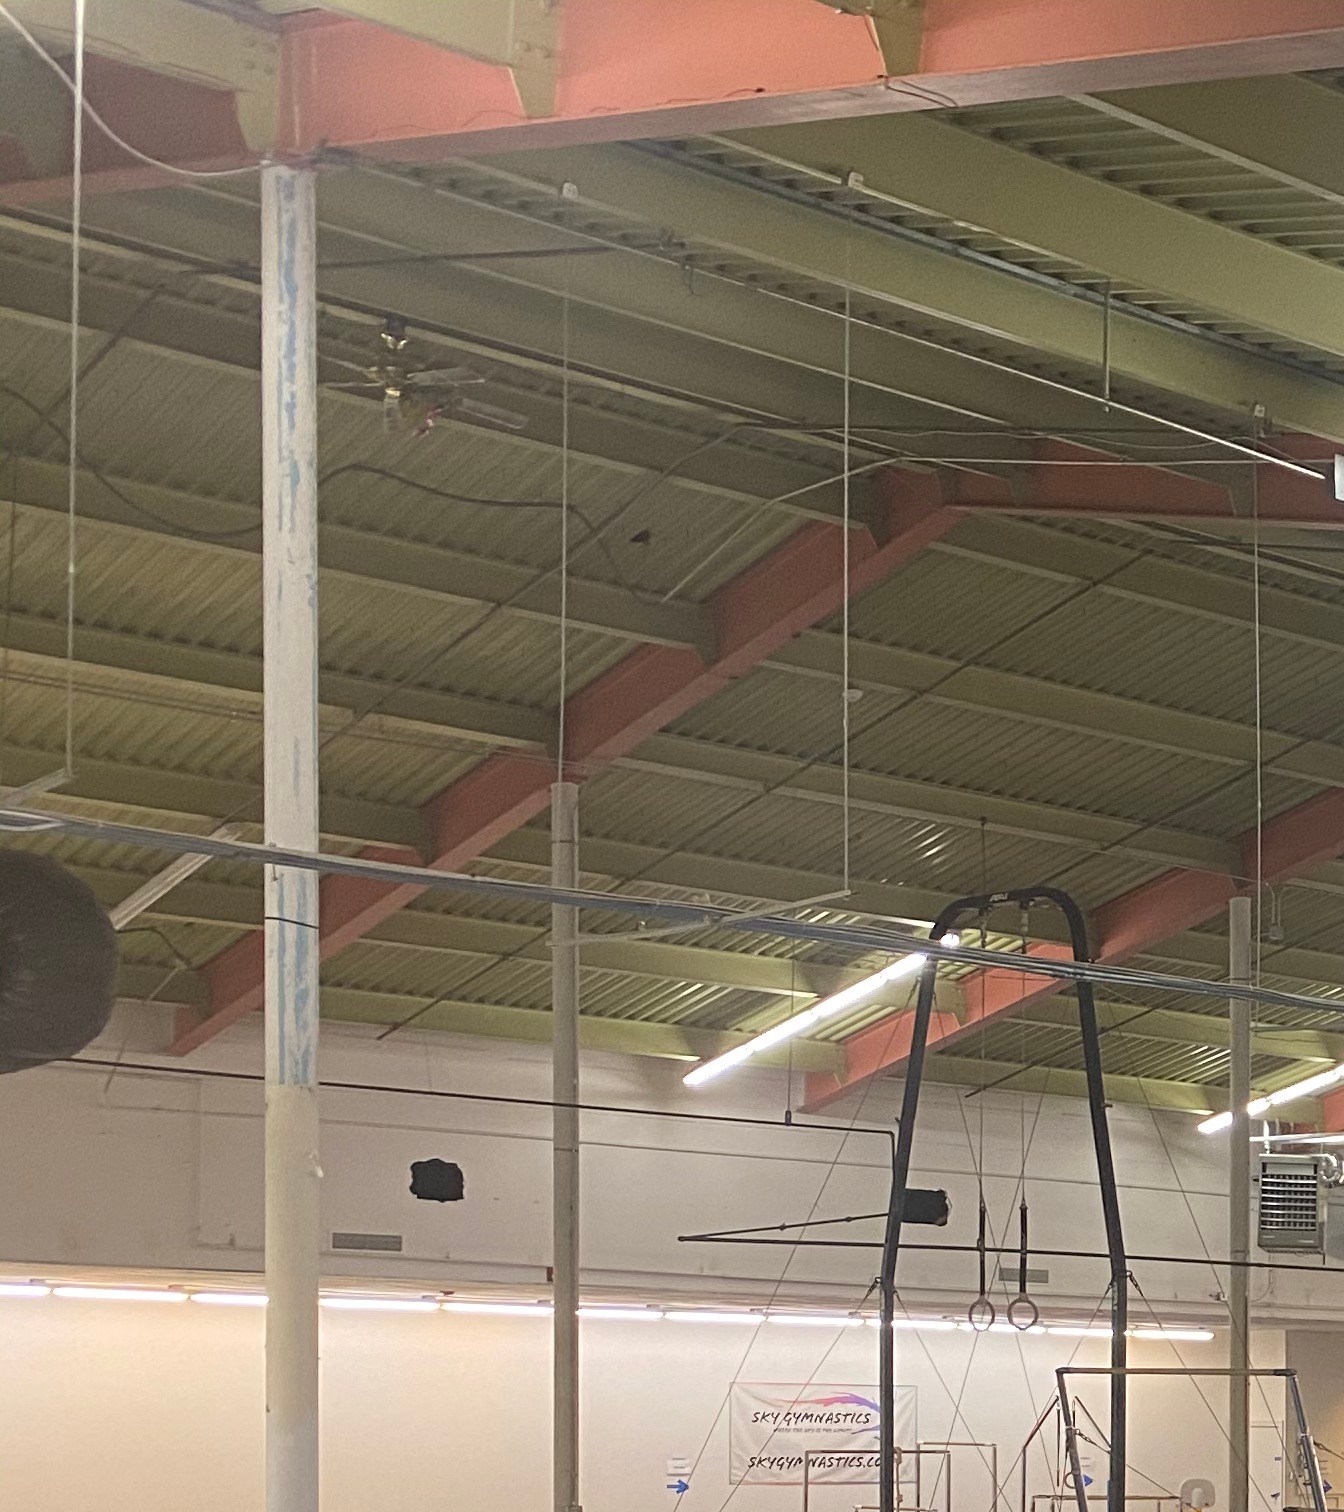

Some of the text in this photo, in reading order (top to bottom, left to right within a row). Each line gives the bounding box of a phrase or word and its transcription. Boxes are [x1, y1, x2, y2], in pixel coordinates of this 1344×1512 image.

[752, 1411, 871, 1426] SKY GYMNASTICS
[748, 1456, 881, 1471] SKYGYMNASTICS.CO
